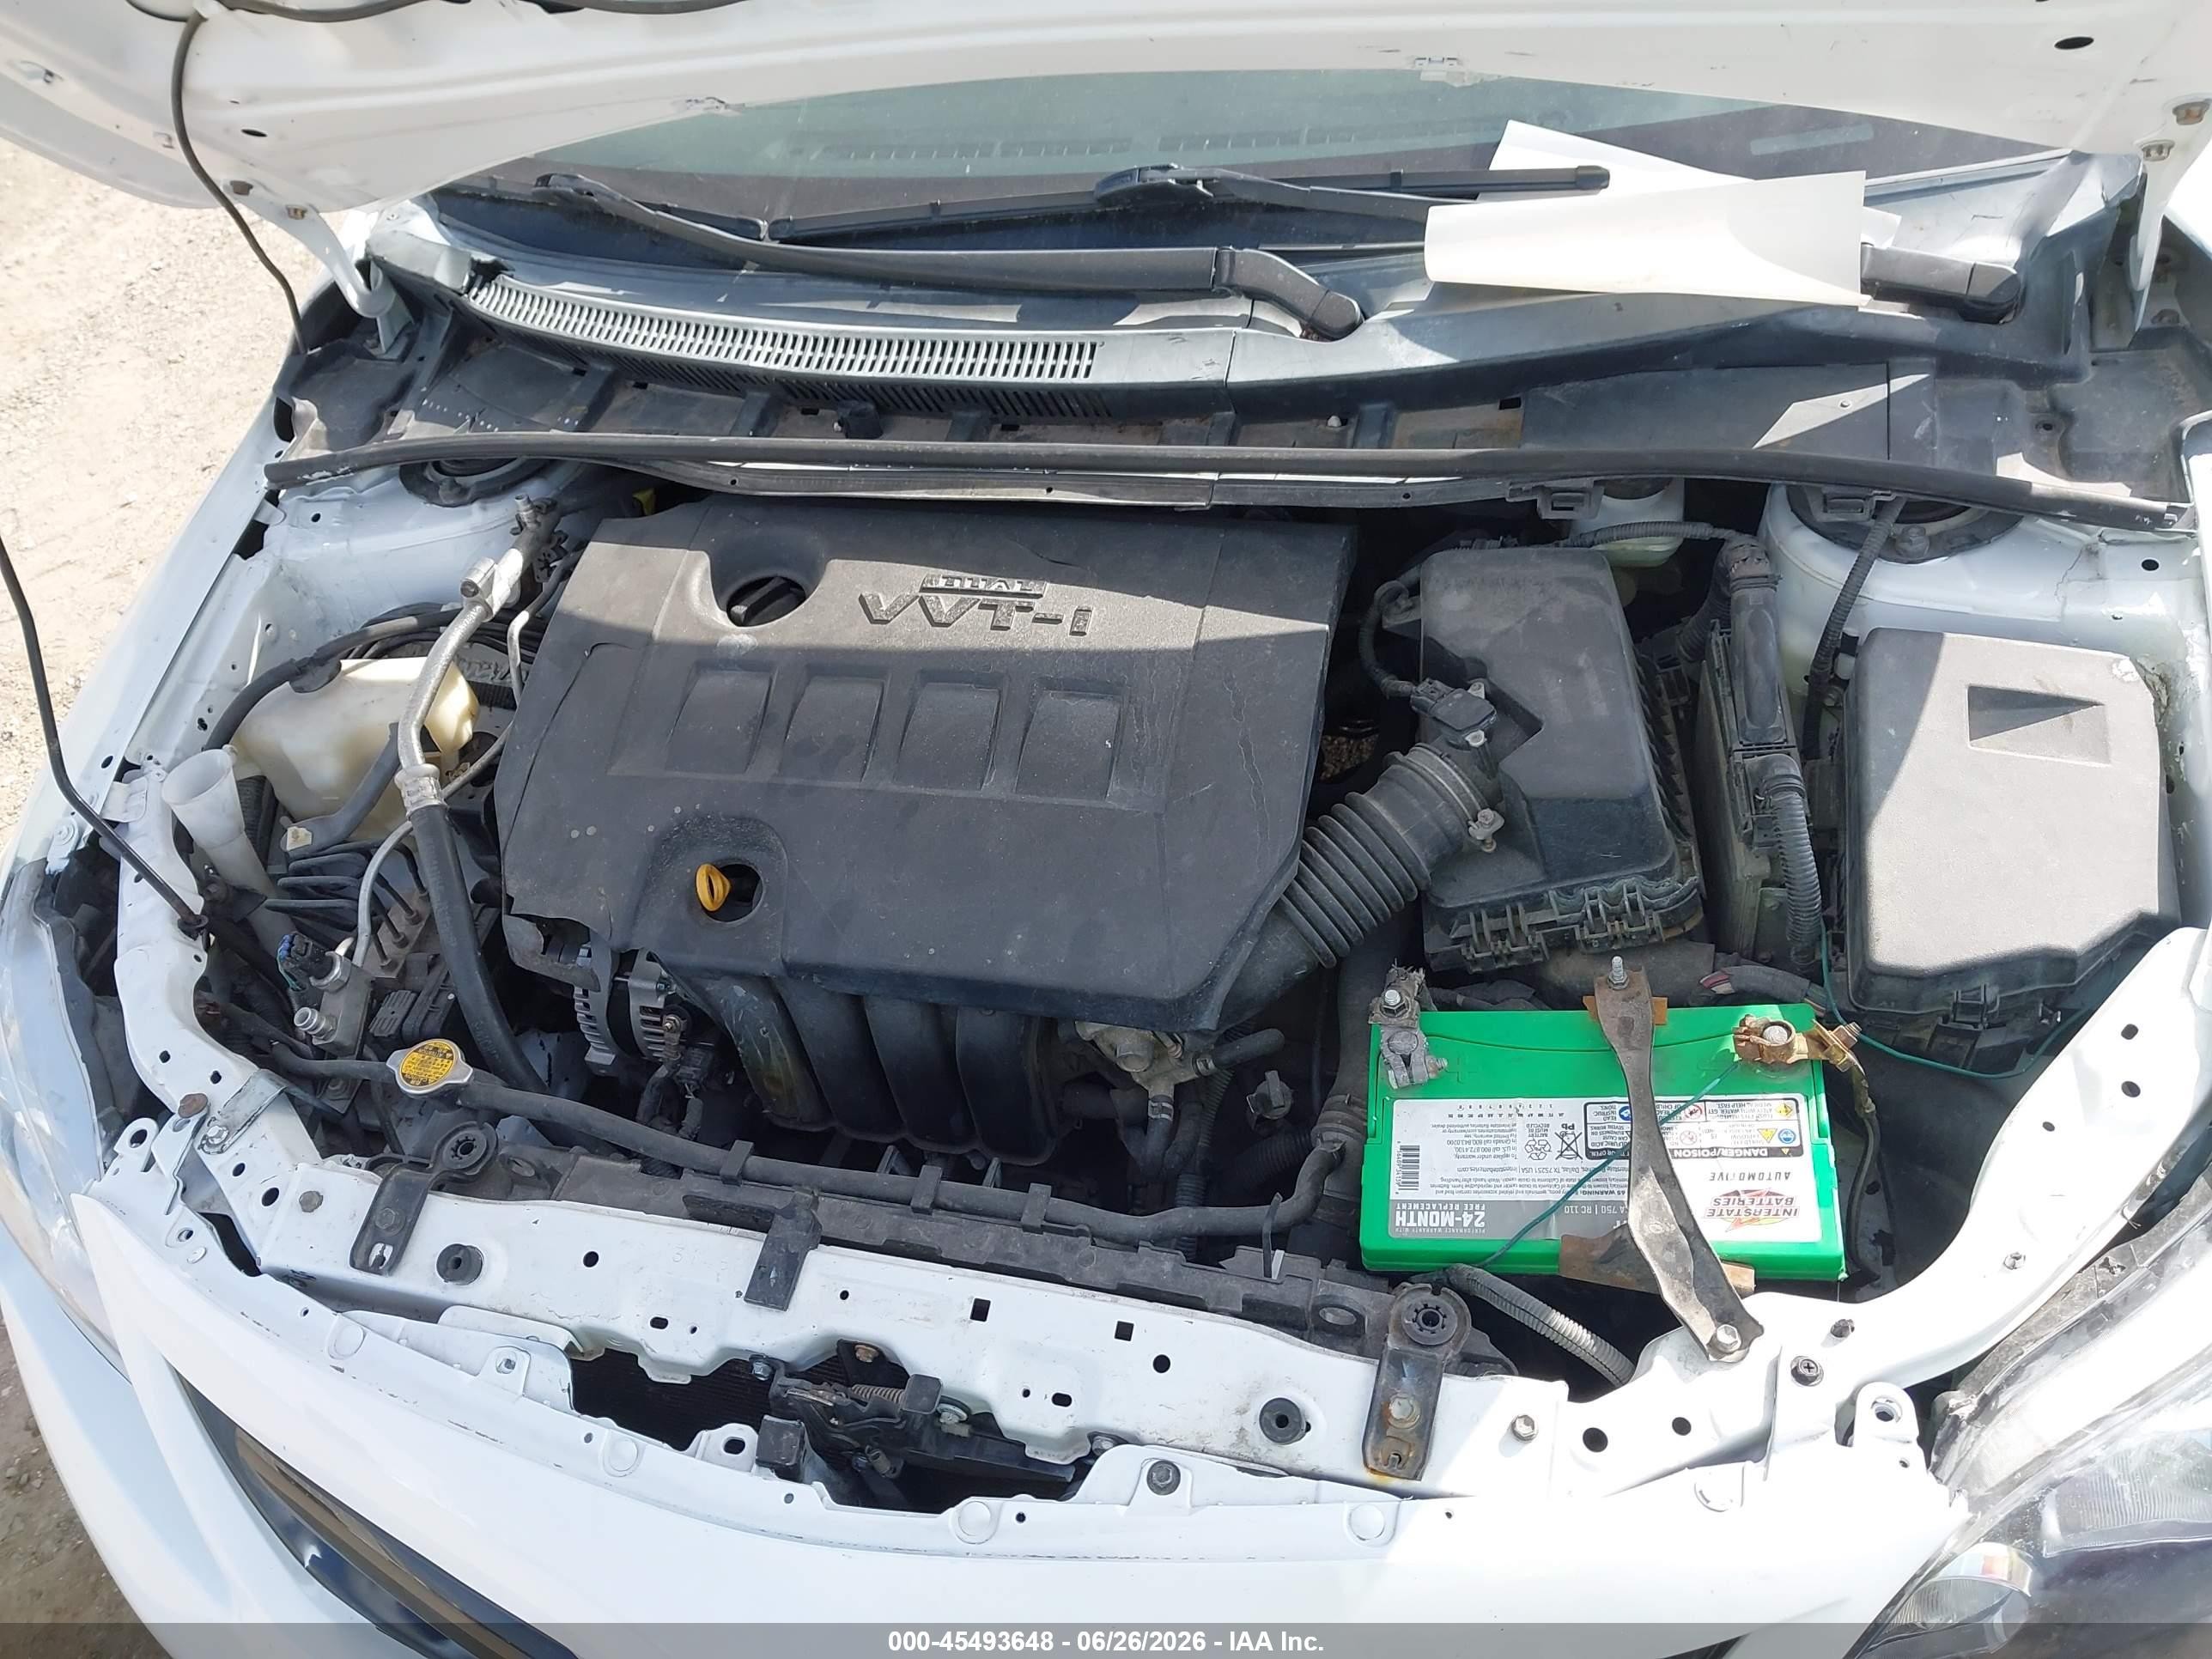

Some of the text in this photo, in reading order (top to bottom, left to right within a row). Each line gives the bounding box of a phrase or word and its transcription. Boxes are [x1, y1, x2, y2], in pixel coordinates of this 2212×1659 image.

[939, 575, 1034, 592] DUAL
[1674, 1148, 1768, 1158] DANGER/POISON
[1711, 1197, 1795, 1207] BATTERIES
[1706, 1208, 1798, 1218] INTERSTATE
[1395, 1211, 1486, 1228] 24-MONTH
